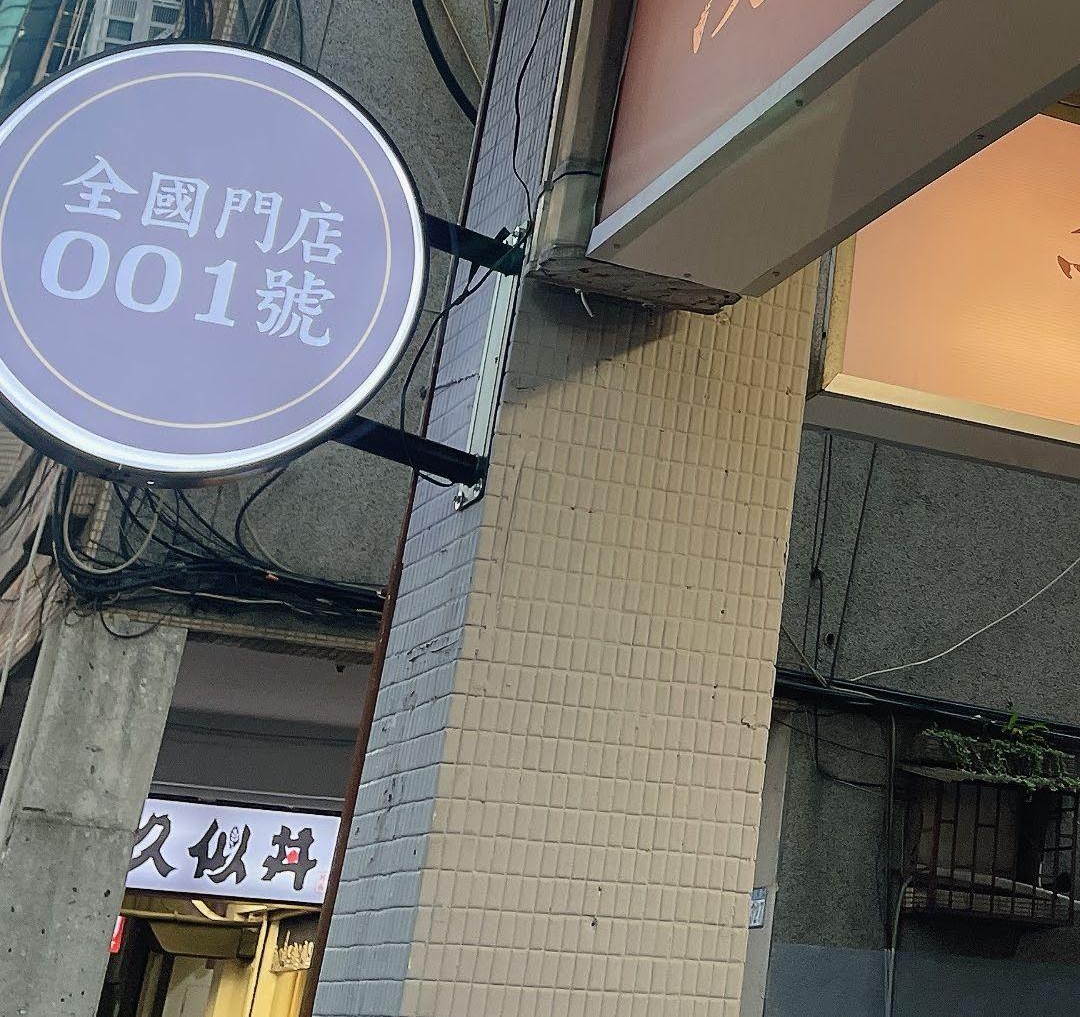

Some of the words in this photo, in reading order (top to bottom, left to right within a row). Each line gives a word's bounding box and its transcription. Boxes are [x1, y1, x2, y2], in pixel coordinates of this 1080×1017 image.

[63, 155, 345, 265] 全國門店
[40, 230, 336, 347] 001號
